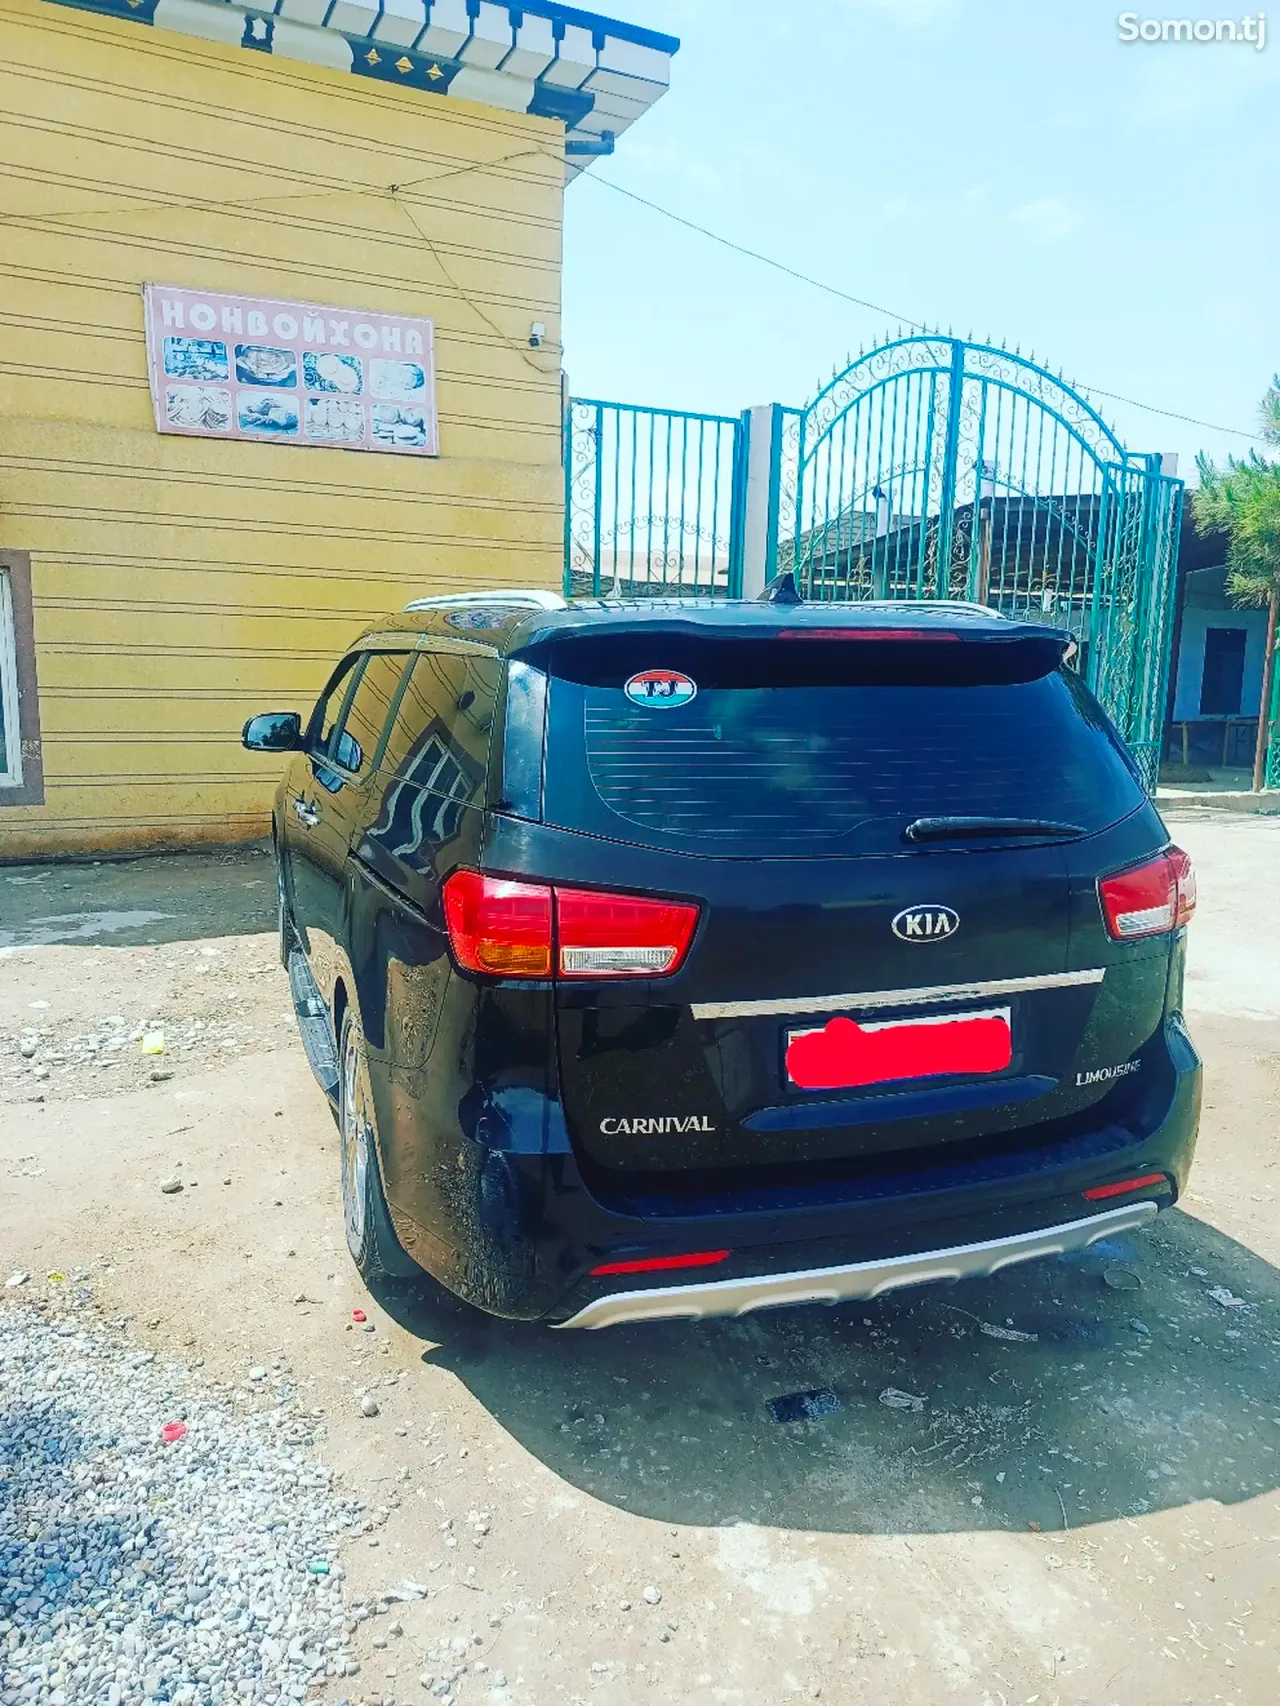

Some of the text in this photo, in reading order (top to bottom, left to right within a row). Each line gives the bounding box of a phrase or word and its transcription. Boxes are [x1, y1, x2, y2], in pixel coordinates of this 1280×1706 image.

[161, 299, 424, 355] НОНВОЙХОНА
[905, 912, 951, 935] KIA
[599, 1115, 716, 1135] CARNIVAL
